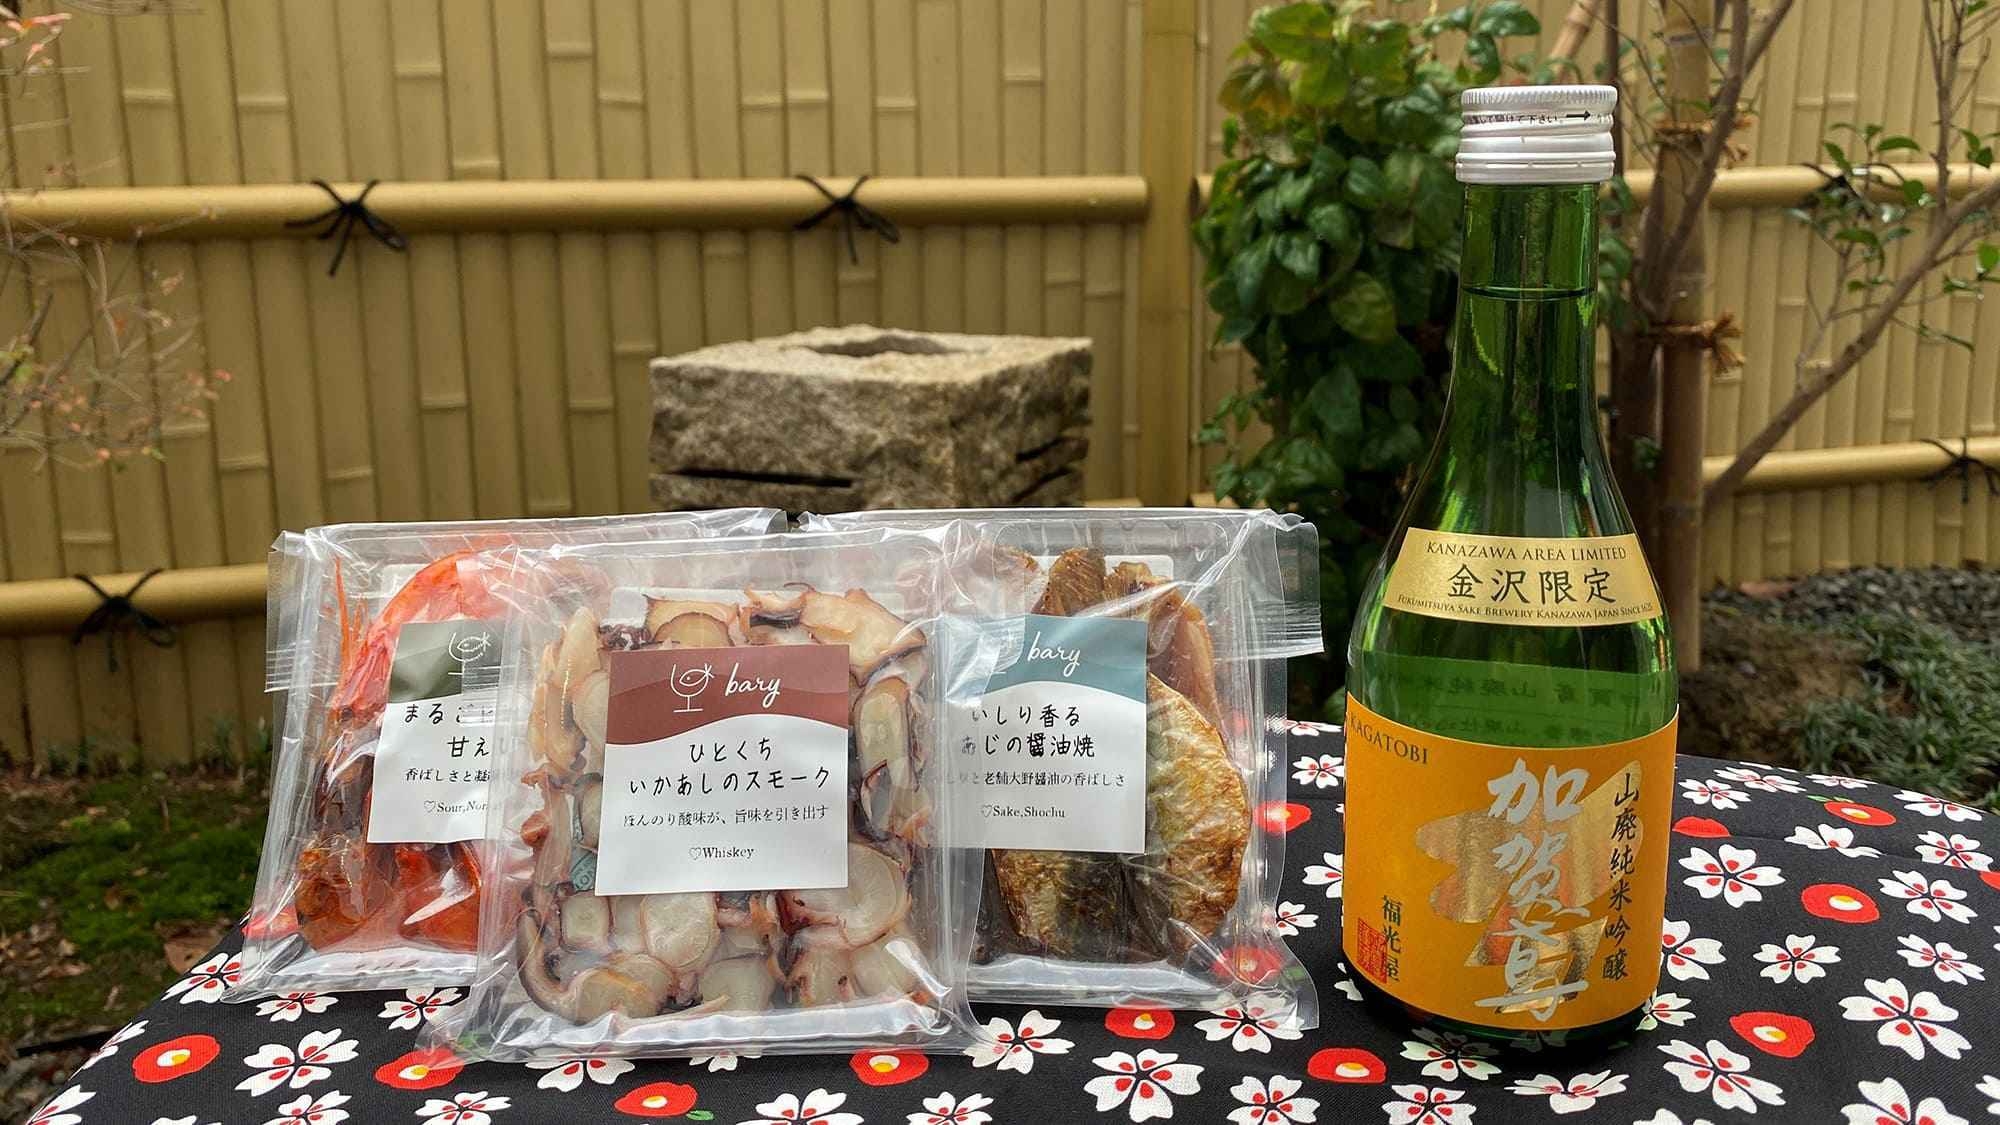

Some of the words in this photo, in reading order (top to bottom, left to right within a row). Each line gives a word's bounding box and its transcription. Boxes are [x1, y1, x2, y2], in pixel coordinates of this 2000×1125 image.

[1427, 541, 1516, 560] KANAZAWA
[1522, 548, 1566, 561] AREA
[1571, 547, 1627, 561] LIMITED
[1447, 563, 1617, 605] 金沢限定
[1457, 604, 1482, 615] SAKE
[1485, 607, 1534, 618] BREWERY
[1536, 609, 1592, 619] KANAZAWA
[1594, 608, 1620, 621] JAPAN
[1620, 606, 1642, 617] SINCE
[1027, 631, 1081, 677] bary
[725, 663, 781, 708] bary
[404, 703, 494, 725] まる
[972, 704, 1081, 728] いしり香る
[690, 737, 772, 763] ひとくち
[961, 733, 1095, 758] あじの醤油焼
[1350, 711, 1428, 765] KAGATOBI
[405, 768, 491, 783] 香ばしさと凝
[630, 766, 829, 796] いかあしのスモーク
[624, 804, 829, 827] ほんのり酸味が、旨味を引き出す
[703, 847, 754, 860] Whiskey
[1602, 773, 1639, 980] 山廃純米吟醸
[1382, 895, 1402, 981] 福光屋
